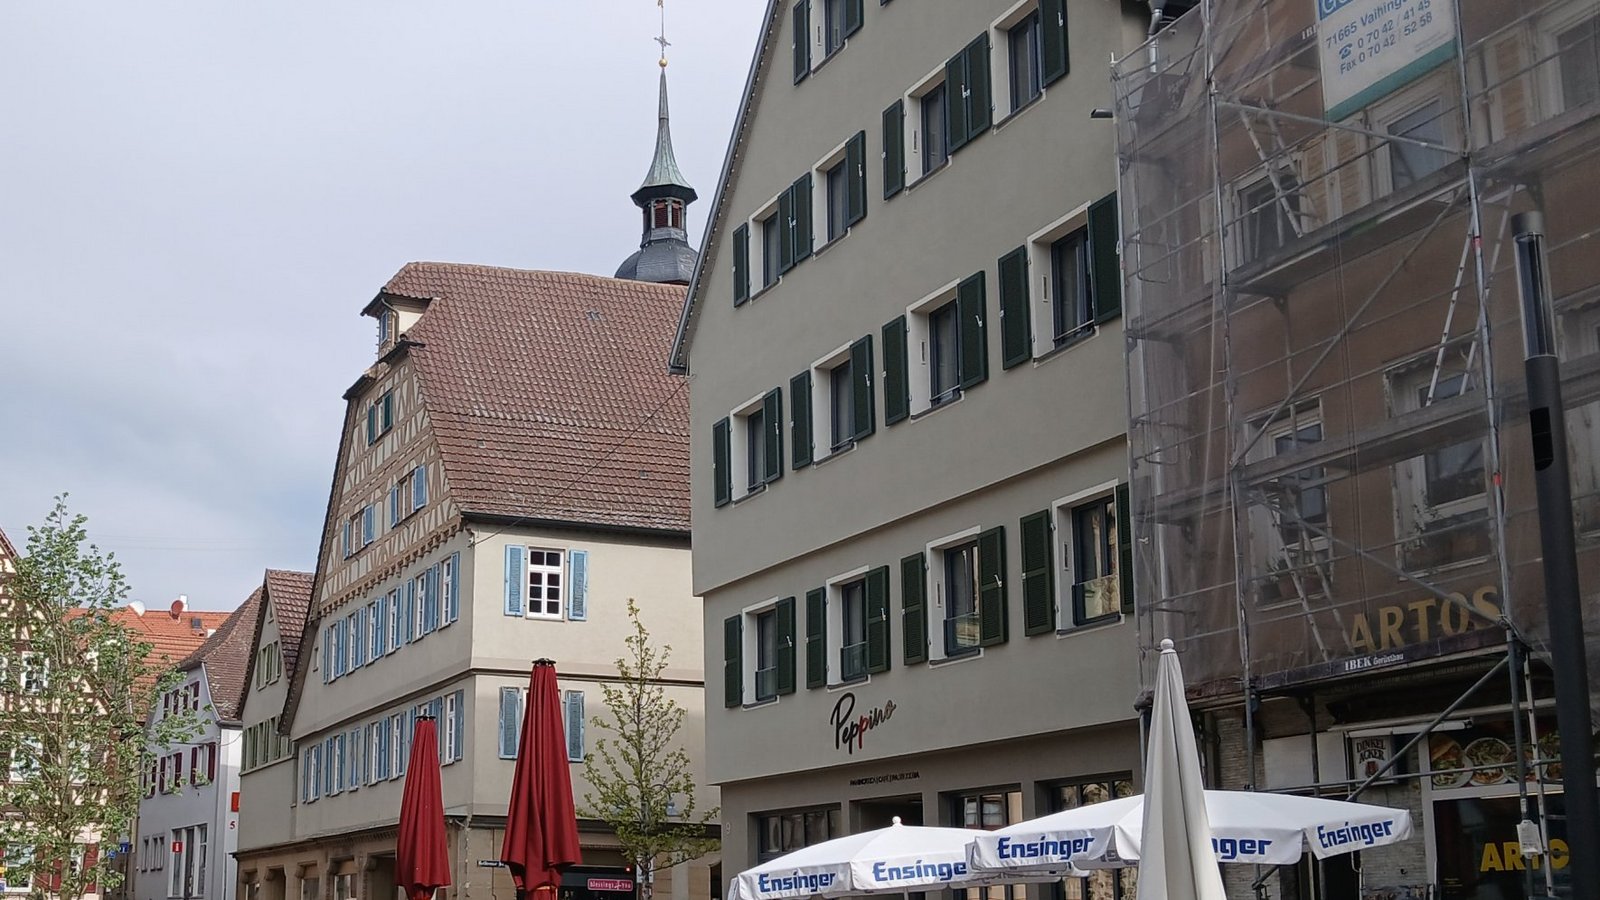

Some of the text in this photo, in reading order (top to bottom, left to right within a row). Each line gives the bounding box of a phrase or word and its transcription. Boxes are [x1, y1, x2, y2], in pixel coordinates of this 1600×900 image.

[1325, 21, 1357, 49] 71665
[1360, 0, 1408, 27] Vaihing
[1357, 38, 1364, 49] 0
[1366, 29, 1380, 43] 70
[1382, 19, 1394, 33] 42
[1403, 7, 1415, 21] 41
[1418, 0, 1431, 11] 45
[1340, 57, 1357, 75] Fax
[1359, 51, 1366, 63] 0
[1368, 43, 1381, 57] 70
[1383, 34, 1396, 48] 42
[1404, 21, 1418, 37] 52
[1420, 11, 1433, 27] 58
[1350, 585, 1502, 653] ARTOS
[1344, 656, 1372, 671] IBEK
[830, 691, 897, 755] Peppino
[1356, 738, 1386, 753] DINKEL
[1359, 749, 1385, 765] ACKER
[229, 820, 236, 830] 5
[1317, 820, 1394, 849] Ensinger
[996, 836, 1096, 861] Ensinger
[758, 871, 836, 893] Ensinger
